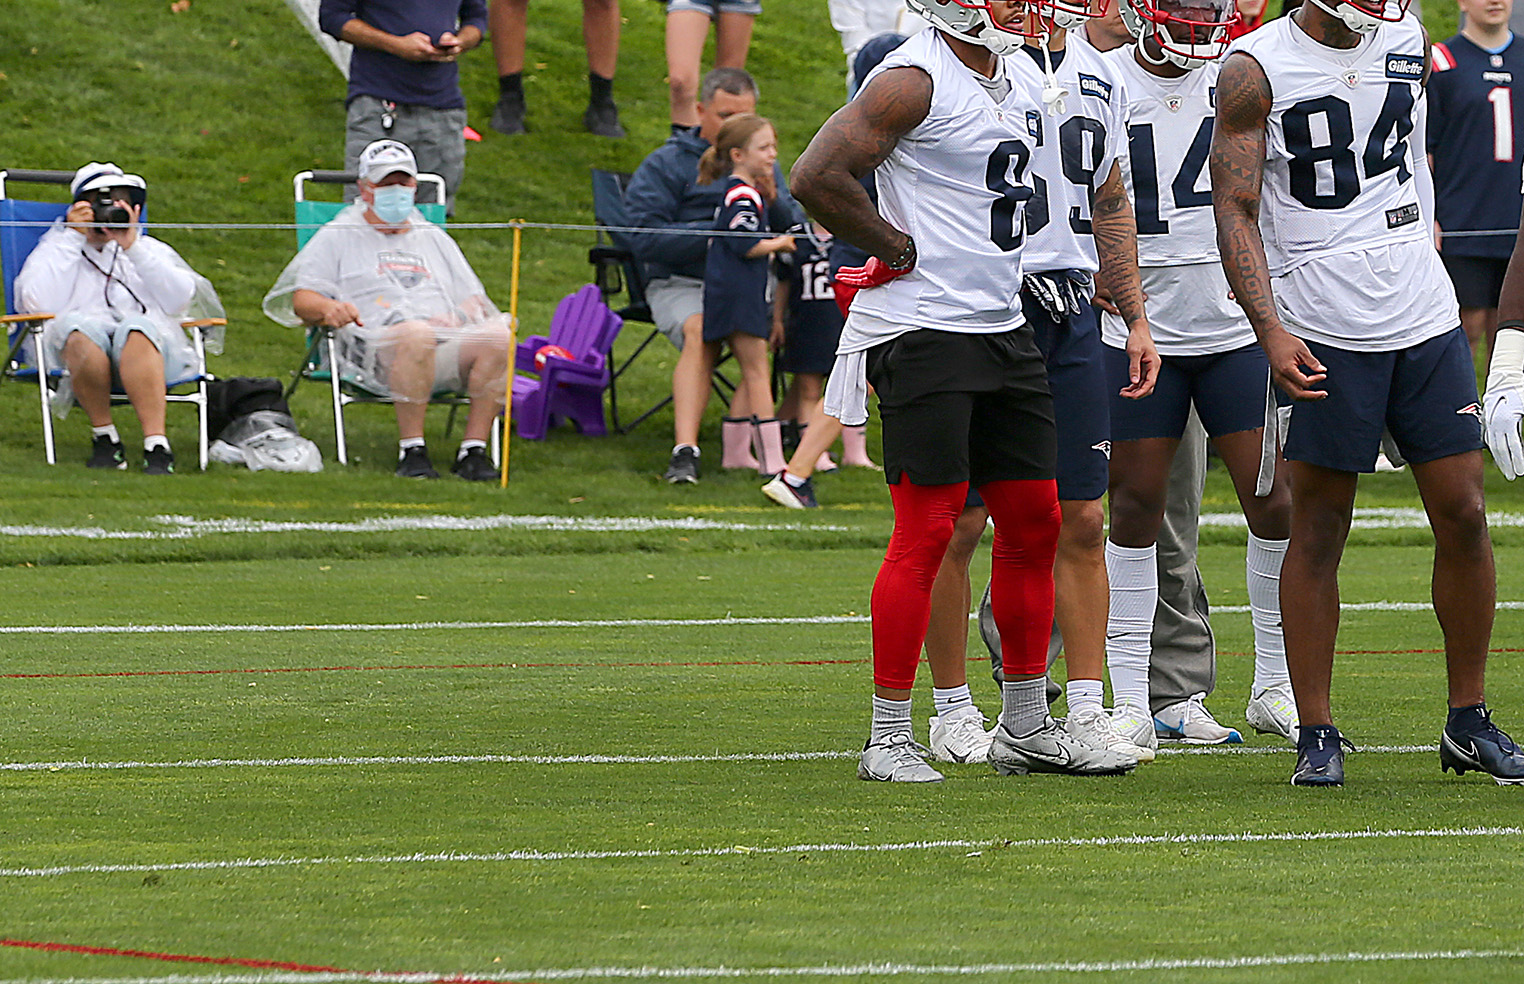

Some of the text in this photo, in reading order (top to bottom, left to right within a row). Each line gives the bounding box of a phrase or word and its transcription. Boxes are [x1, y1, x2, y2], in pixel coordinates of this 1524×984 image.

[1388, 59, 1424, 76] Gillette
[1281, 82, 1415, 209] 84
[1488, 86, 1514, 163] 1
[1125, 116, 1214, 235] 14
[801, 260, 836, 300] 12
